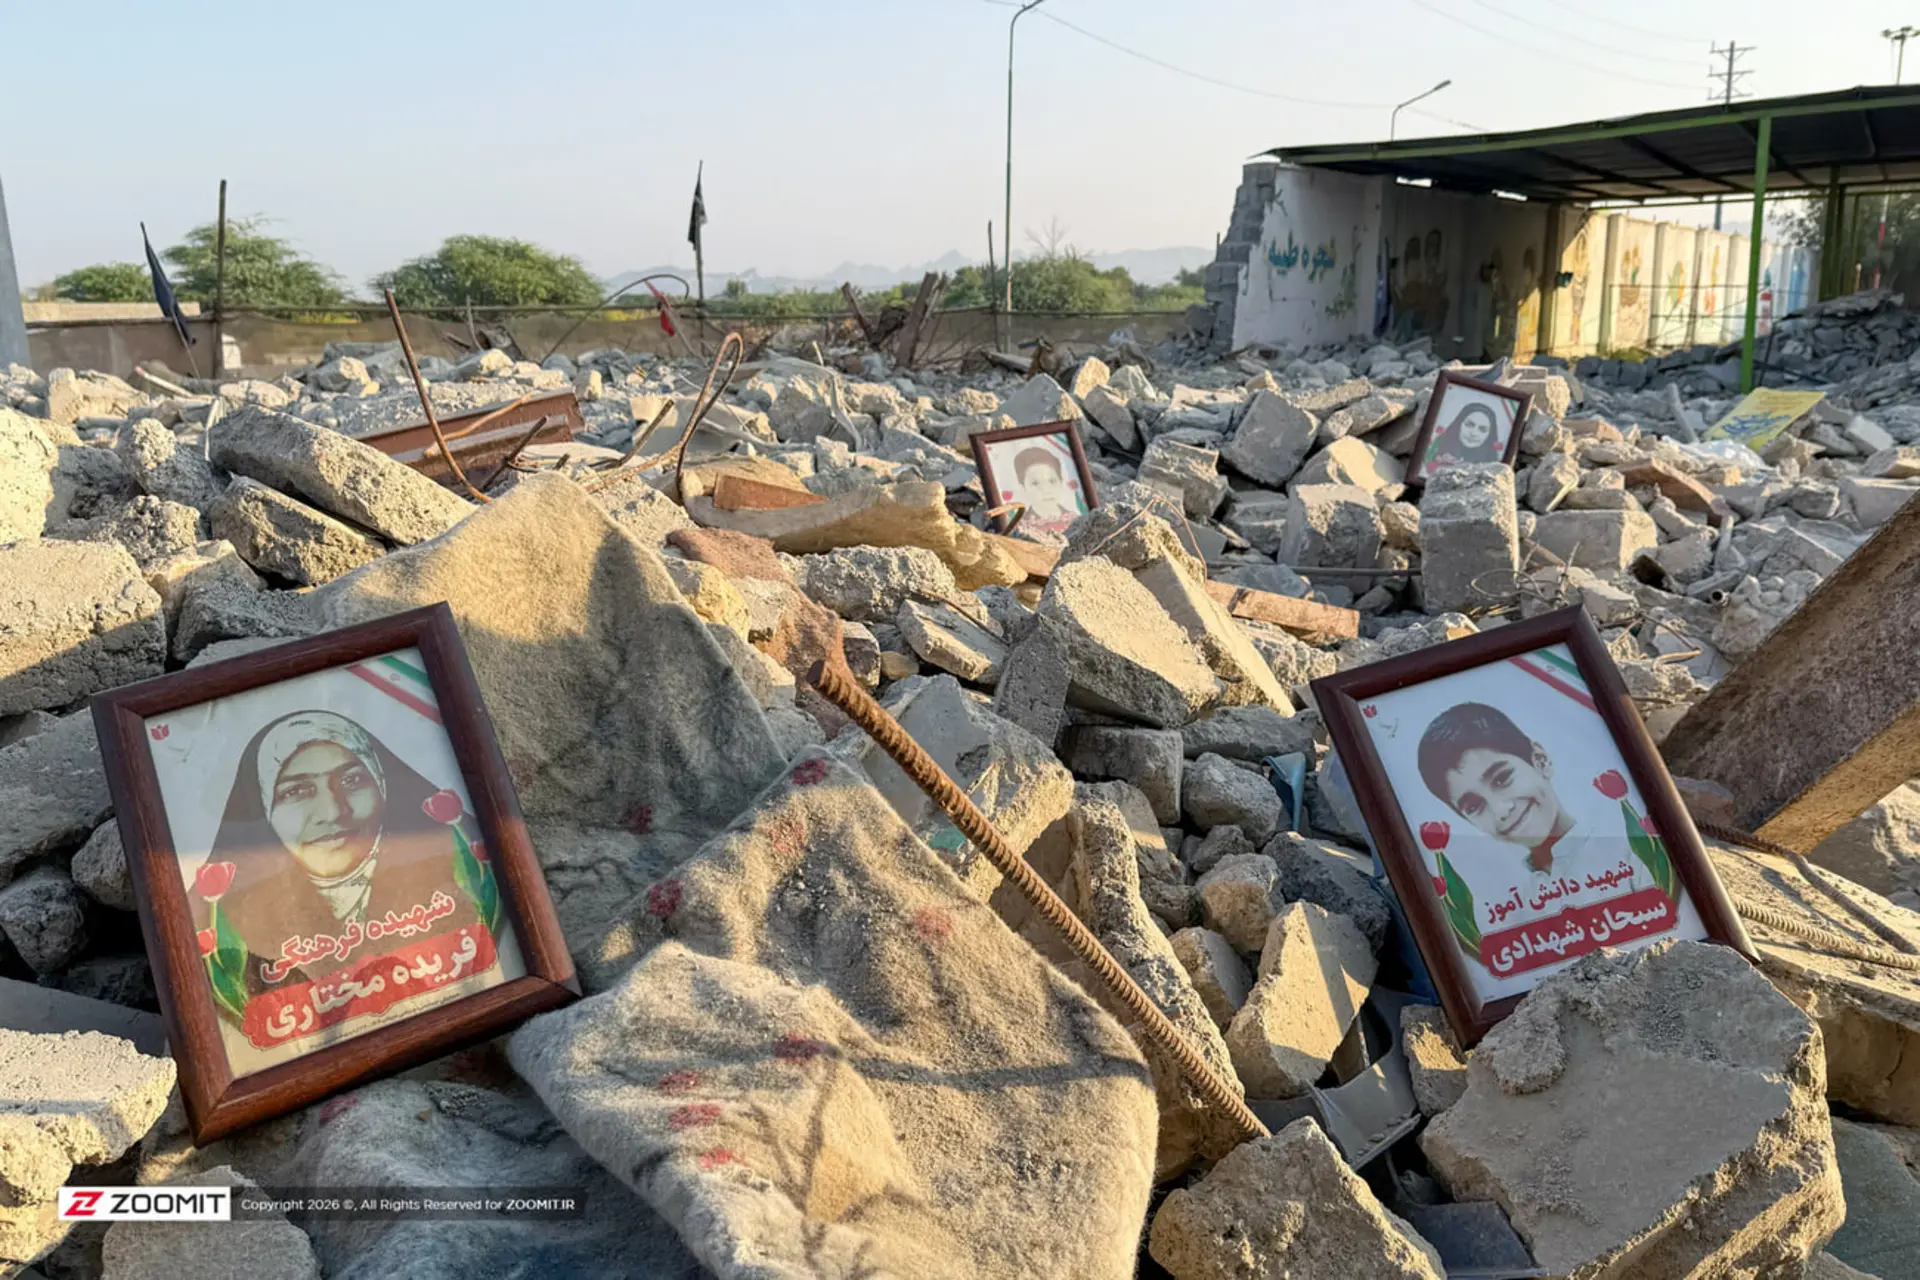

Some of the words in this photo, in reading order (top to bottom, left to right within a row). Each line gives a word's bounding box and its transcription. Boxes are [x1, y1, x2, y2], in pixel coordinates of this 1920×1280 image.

[1530, 876, 1580, 910] دانش
[1585, 860, 1635, 891] شهید
[366, 890, 456, 940] شهیده
[1484, 887, 1524, 924] آموز
[1590, 901, 1668, 942] سبحان
[260, 917, 365, 984] فرهنگی
[392, 928, 478, 985] فریده
[1492, 919, 1585, 971] شهدادی
[266, 970, 386, 1038] مختاری
